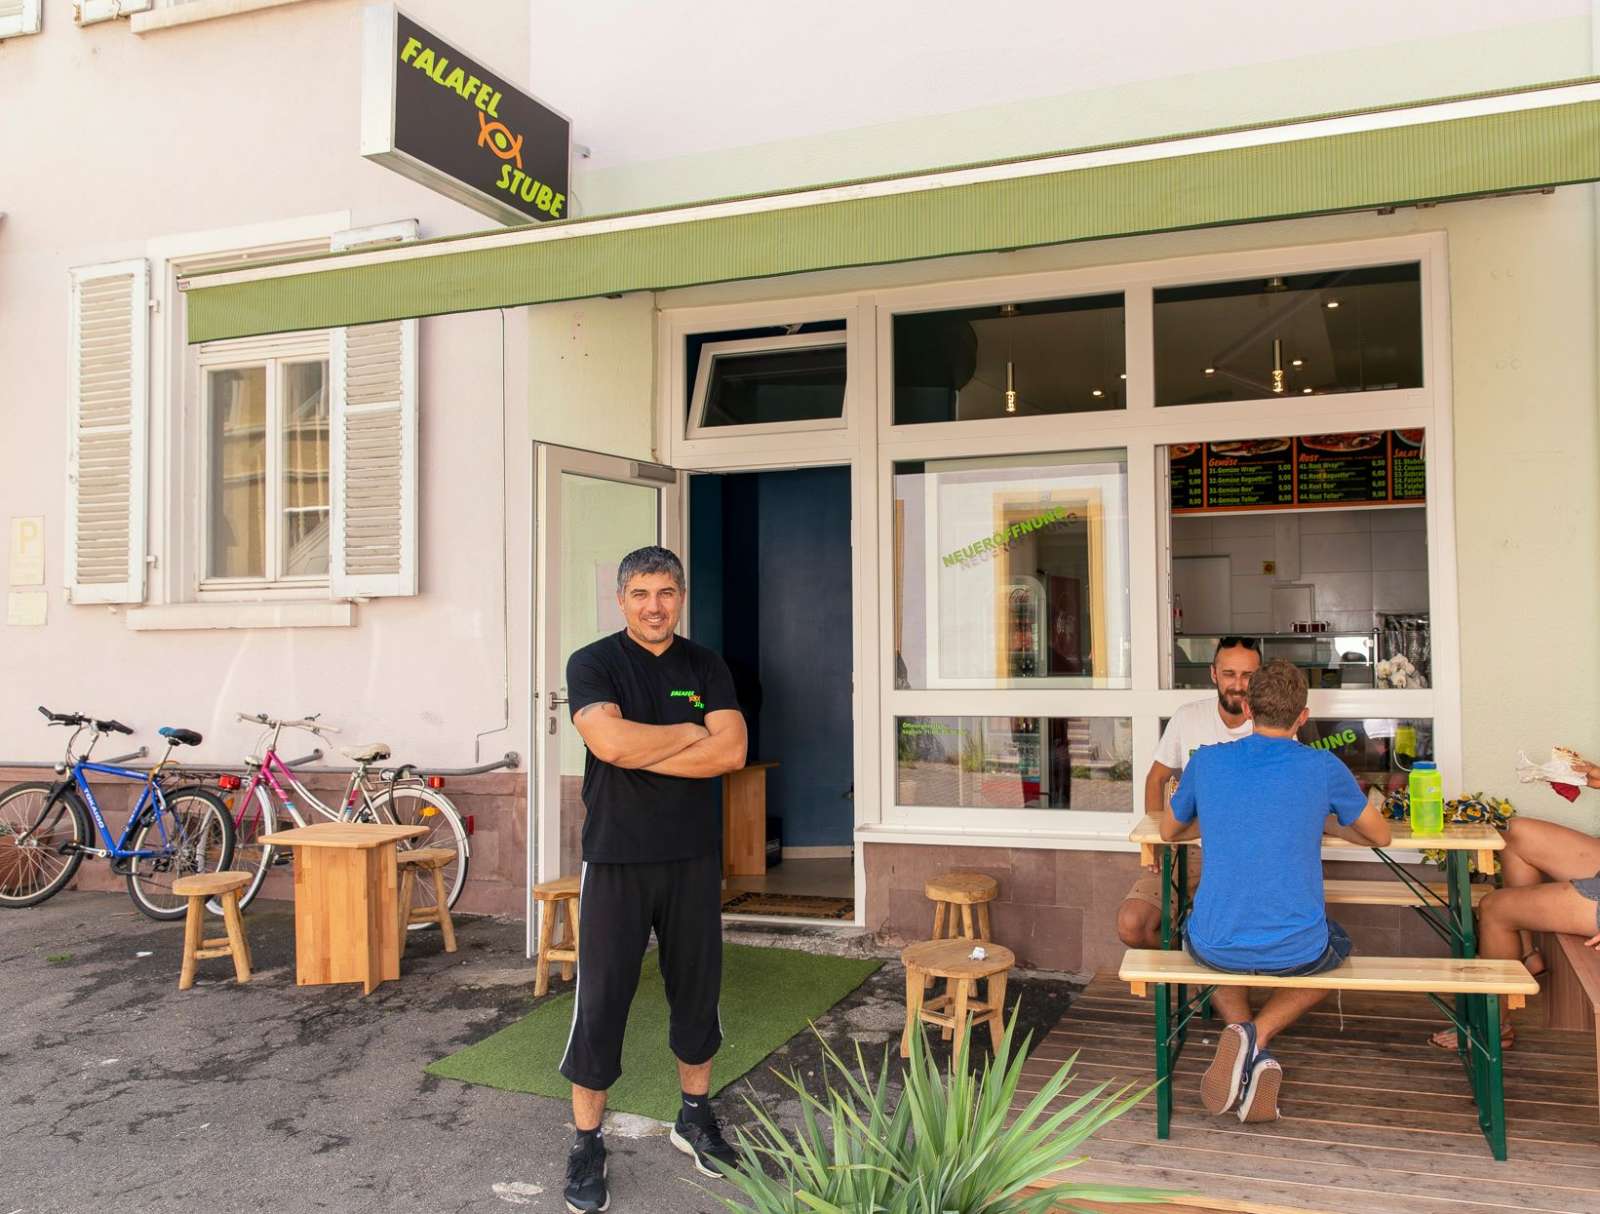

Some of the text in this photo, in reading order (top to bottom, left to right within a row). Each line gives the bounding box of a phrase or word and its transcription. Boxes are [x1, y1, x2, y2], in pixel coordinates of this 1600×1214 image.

[400, 37, 503, 118] FALAFEL
[496, 164, 566, 218] STUBE
[19, 520, 38, 554] P
